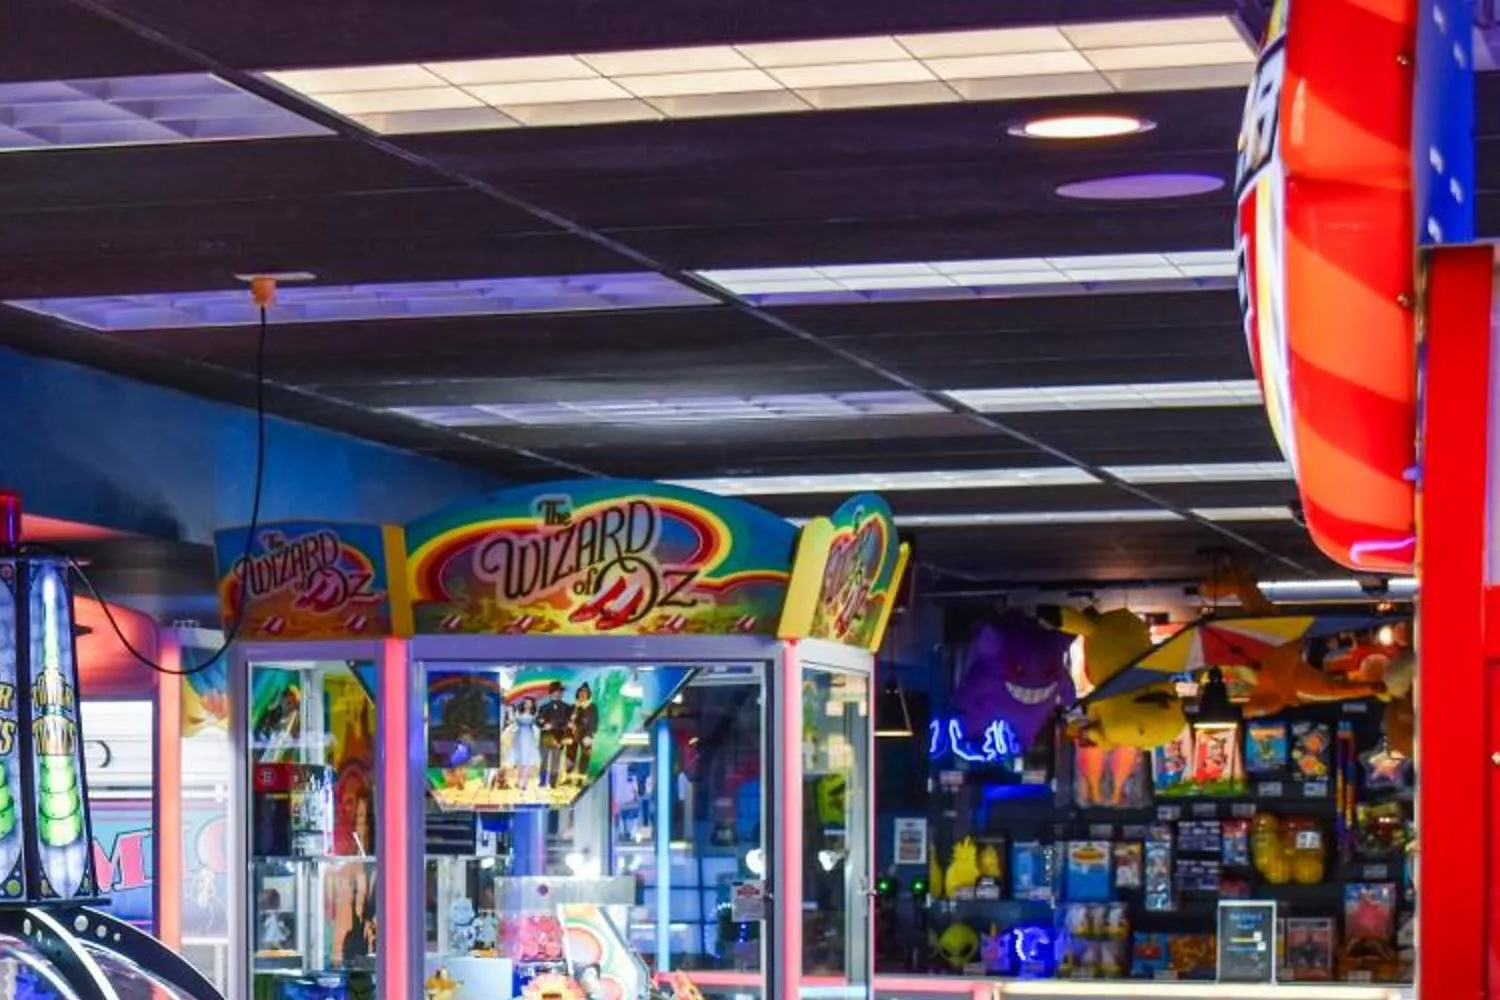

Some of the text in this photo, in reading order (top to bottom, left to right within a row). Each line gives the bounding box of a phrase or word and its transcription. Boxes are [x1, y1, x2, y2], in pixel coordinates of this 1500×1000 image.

[537, 499, 572, 525] The
[235, 532, 339, 595] WIZARD
[481, 500, 656, 599] WIZARD
[573, 567, 598, 595] of
